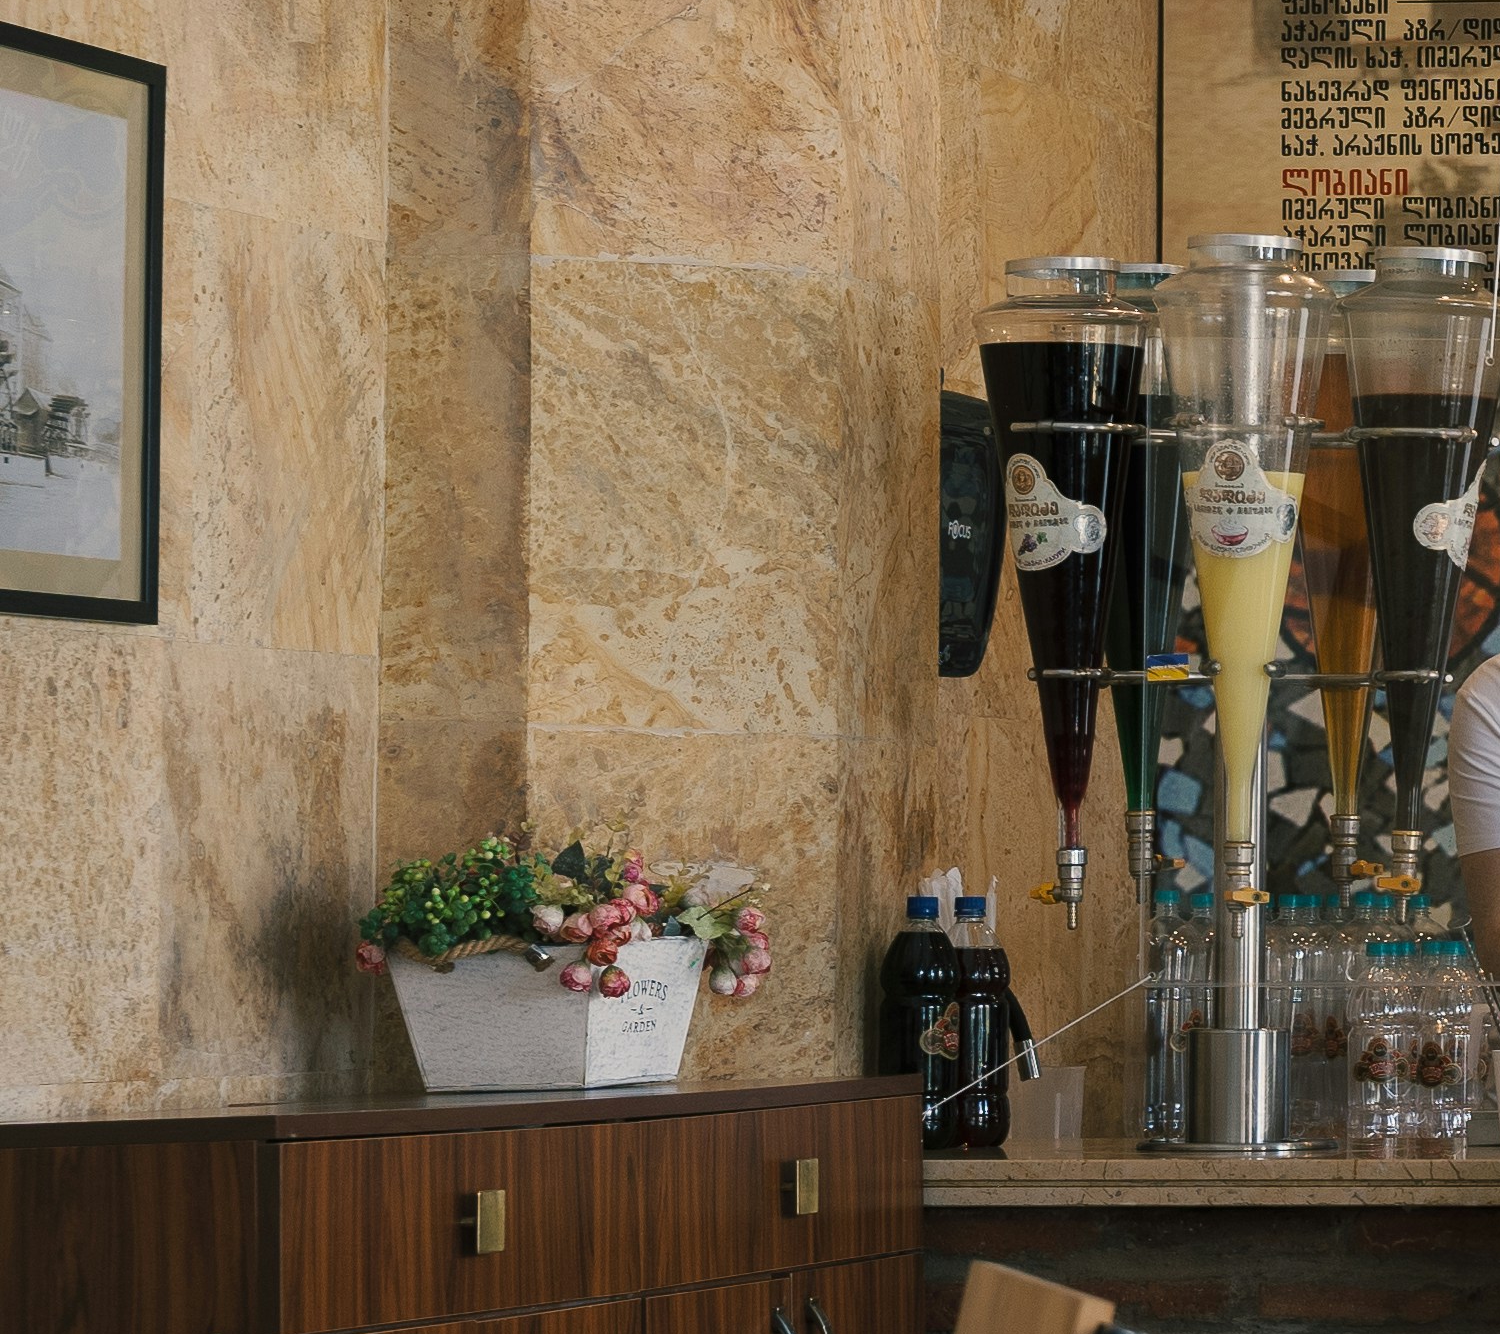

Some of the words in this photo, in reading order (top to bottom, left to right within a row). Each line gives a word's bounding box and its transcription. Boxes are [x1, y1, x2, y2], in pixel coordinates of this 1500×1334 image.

[1281, 19, 1386, 42] აჭარული
[1281, 46, 1357, 69] დალის
[1281, 80, 1390, 102] ნახევრად
[1281, 107, 1386, 129] მეგრული
[1282, 168, 1409, 196] ლობიანი
[1282, 197, 1385, 220] იმერული
